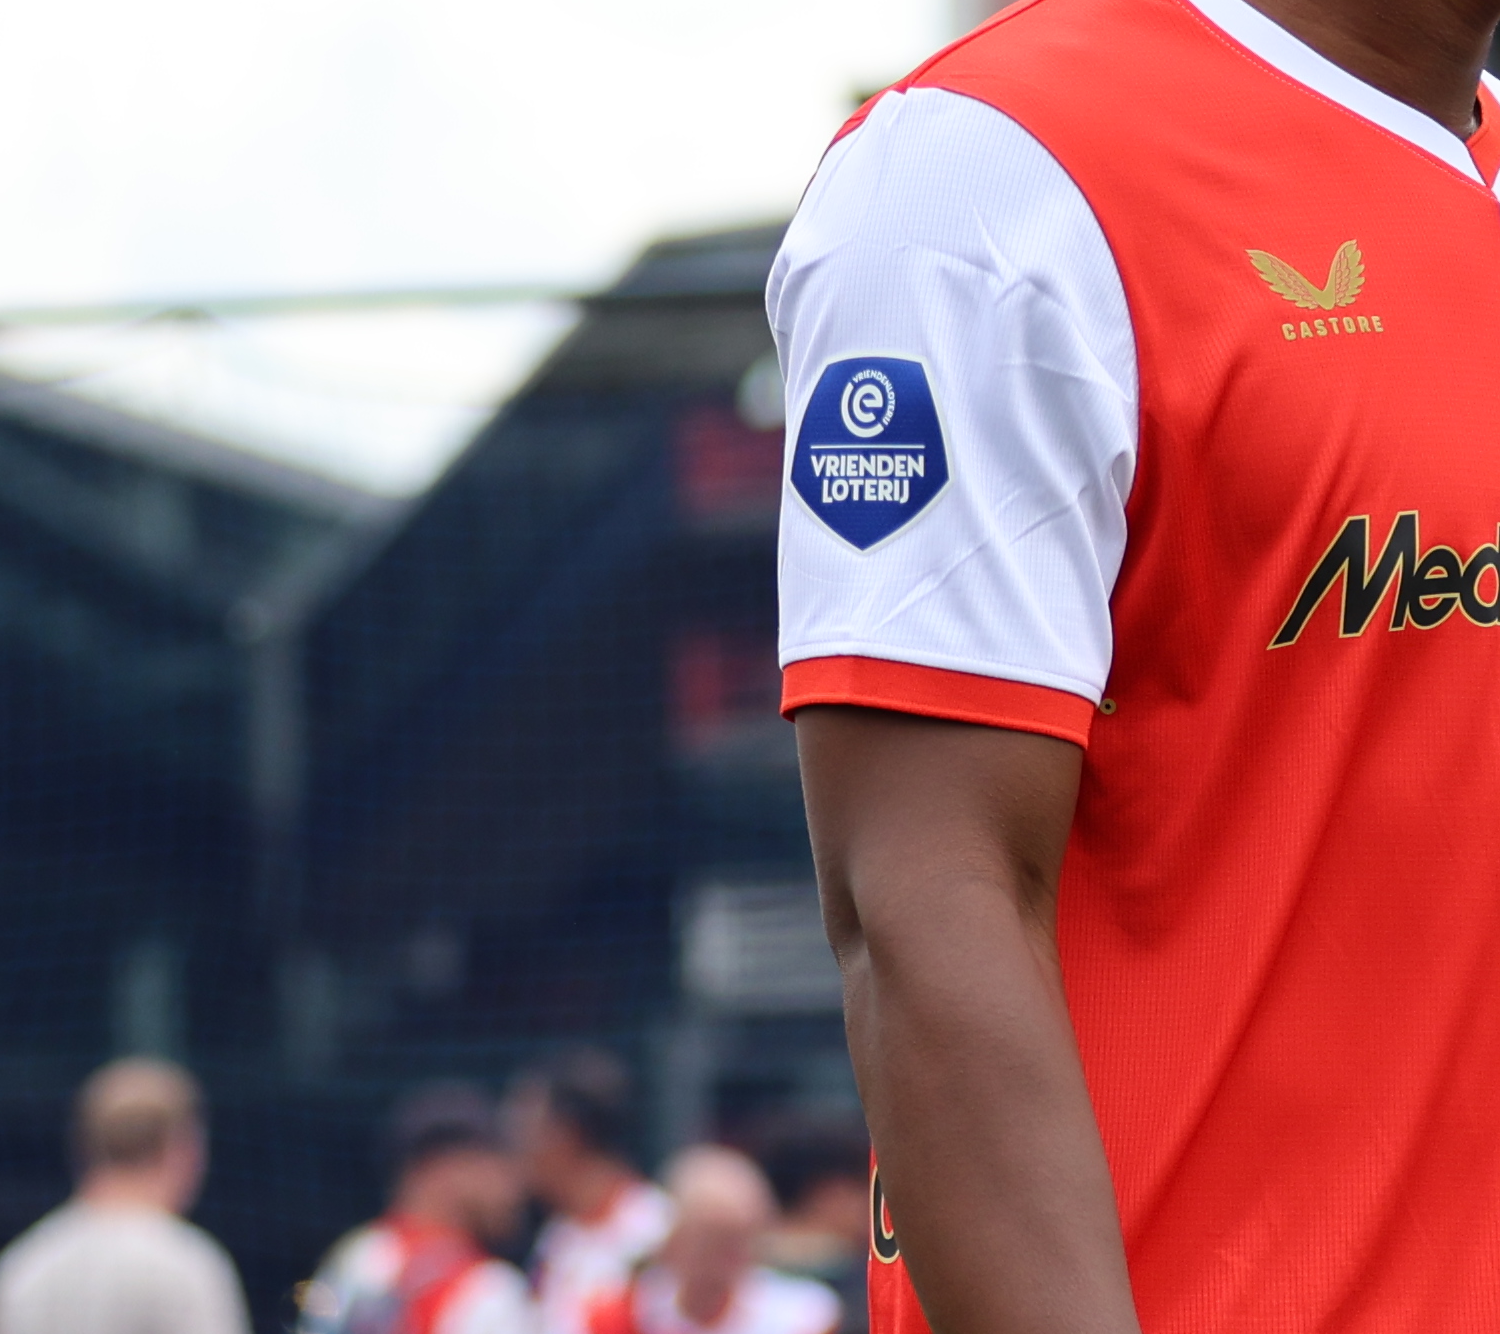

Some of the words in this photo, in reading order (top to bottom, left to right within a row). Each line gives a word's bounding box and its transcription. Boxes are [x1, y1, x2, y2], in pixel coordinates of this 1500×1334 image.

[1281, 315, 1385, 342] CASTORE
[810, 454, 926, 478] VRIENDEN
[821, 479, 910, 505] LOTERIJ
